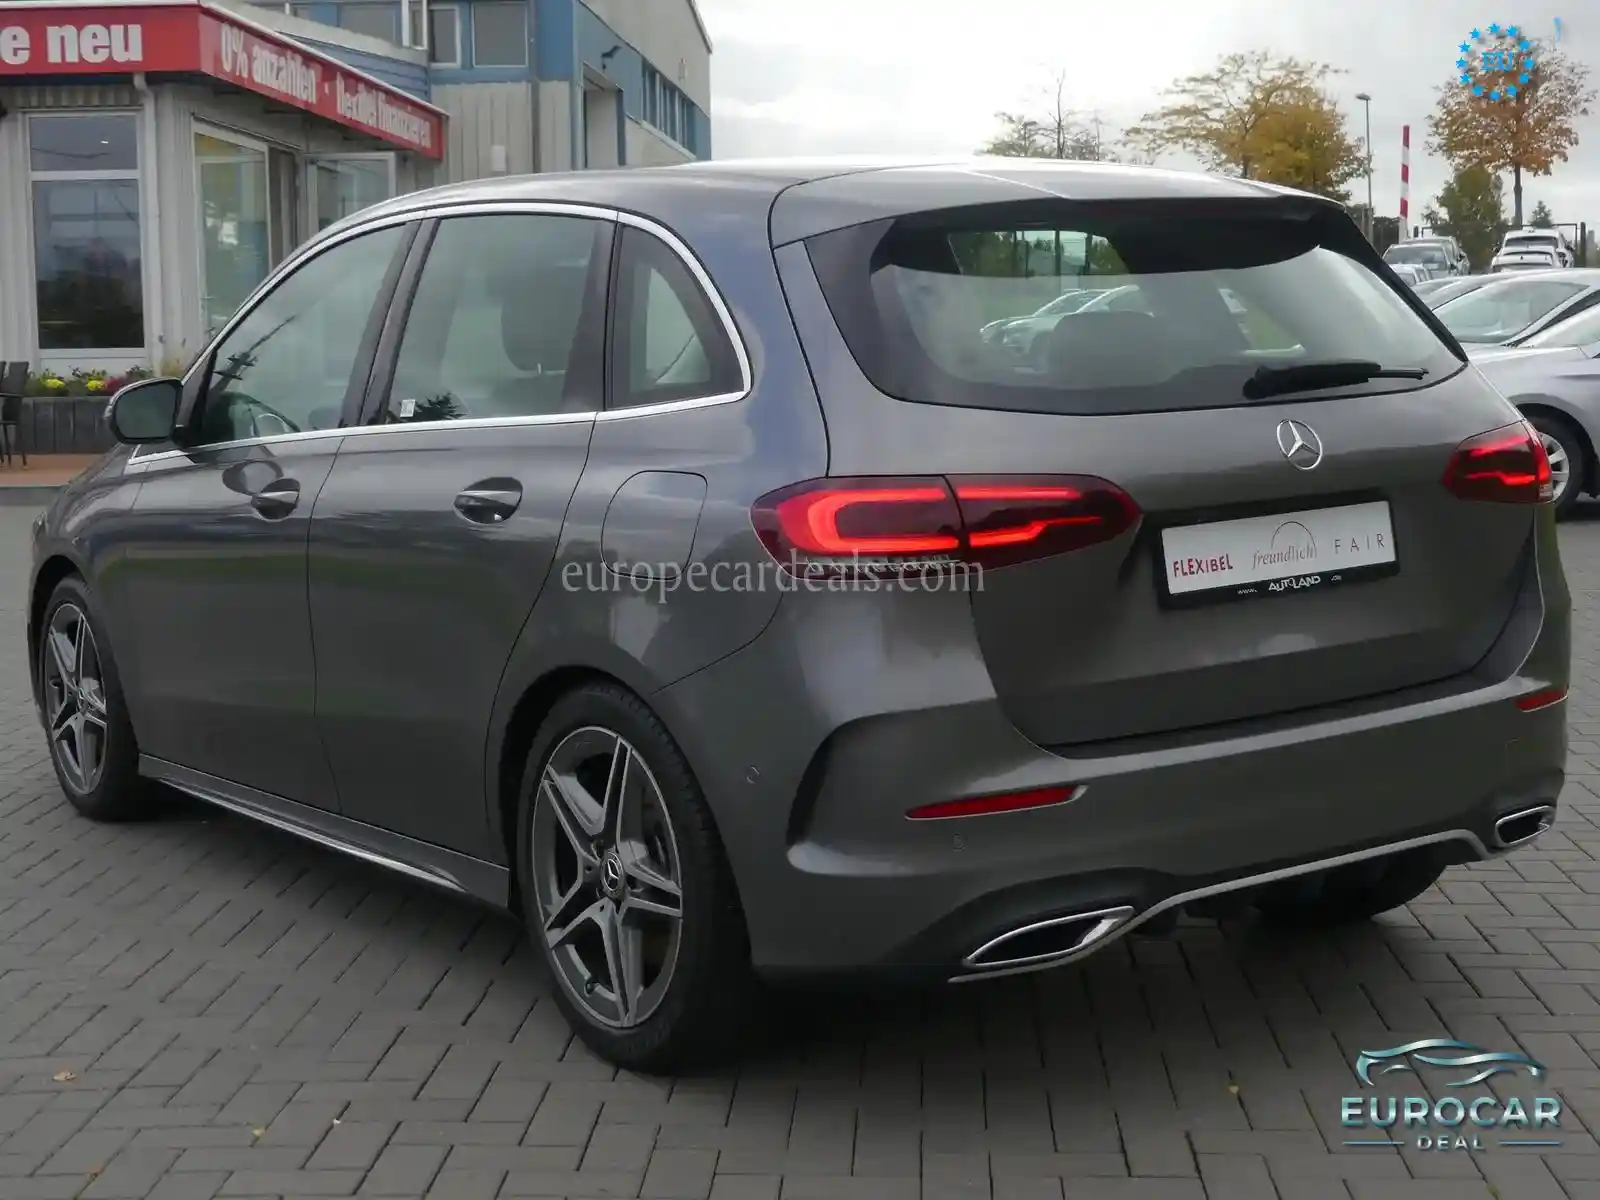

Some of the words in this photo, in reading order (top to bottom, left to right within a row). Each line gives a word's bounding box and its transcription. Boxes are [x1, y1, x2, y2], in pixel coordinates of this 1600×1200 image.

[46, 24, 142, 63] neu
[221, 22, 248, 78] 0%
[252, 44, 317, 104] anzahlen
[1173, 553, 1234, 577] FLEXIBEL
[1251, 542, 1318, 571] freundlich
[1334, 533, 1385, 554] FAIR
